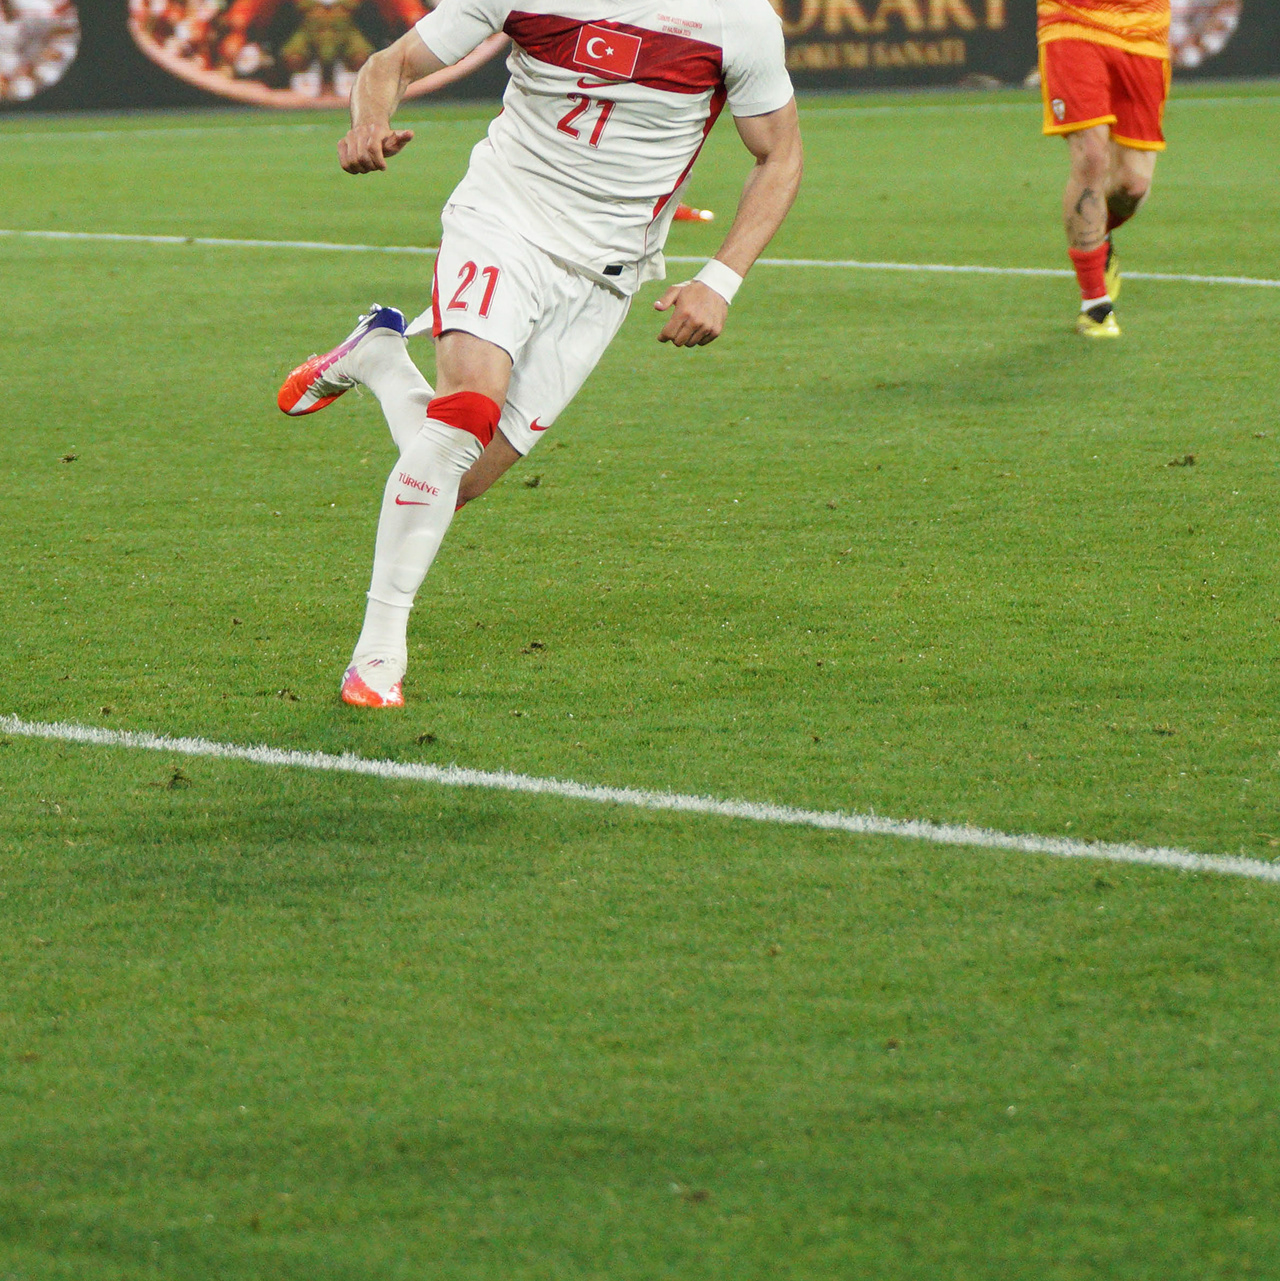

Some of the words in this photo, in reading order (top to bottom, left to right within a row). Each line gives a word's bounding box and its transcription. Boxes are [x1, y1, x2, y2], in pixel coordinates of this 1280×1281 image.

[557, 92, 616, 148] 21
[446, 260, 502, 319] 21
[399, 472, 440, 497] TÜRKİYE
